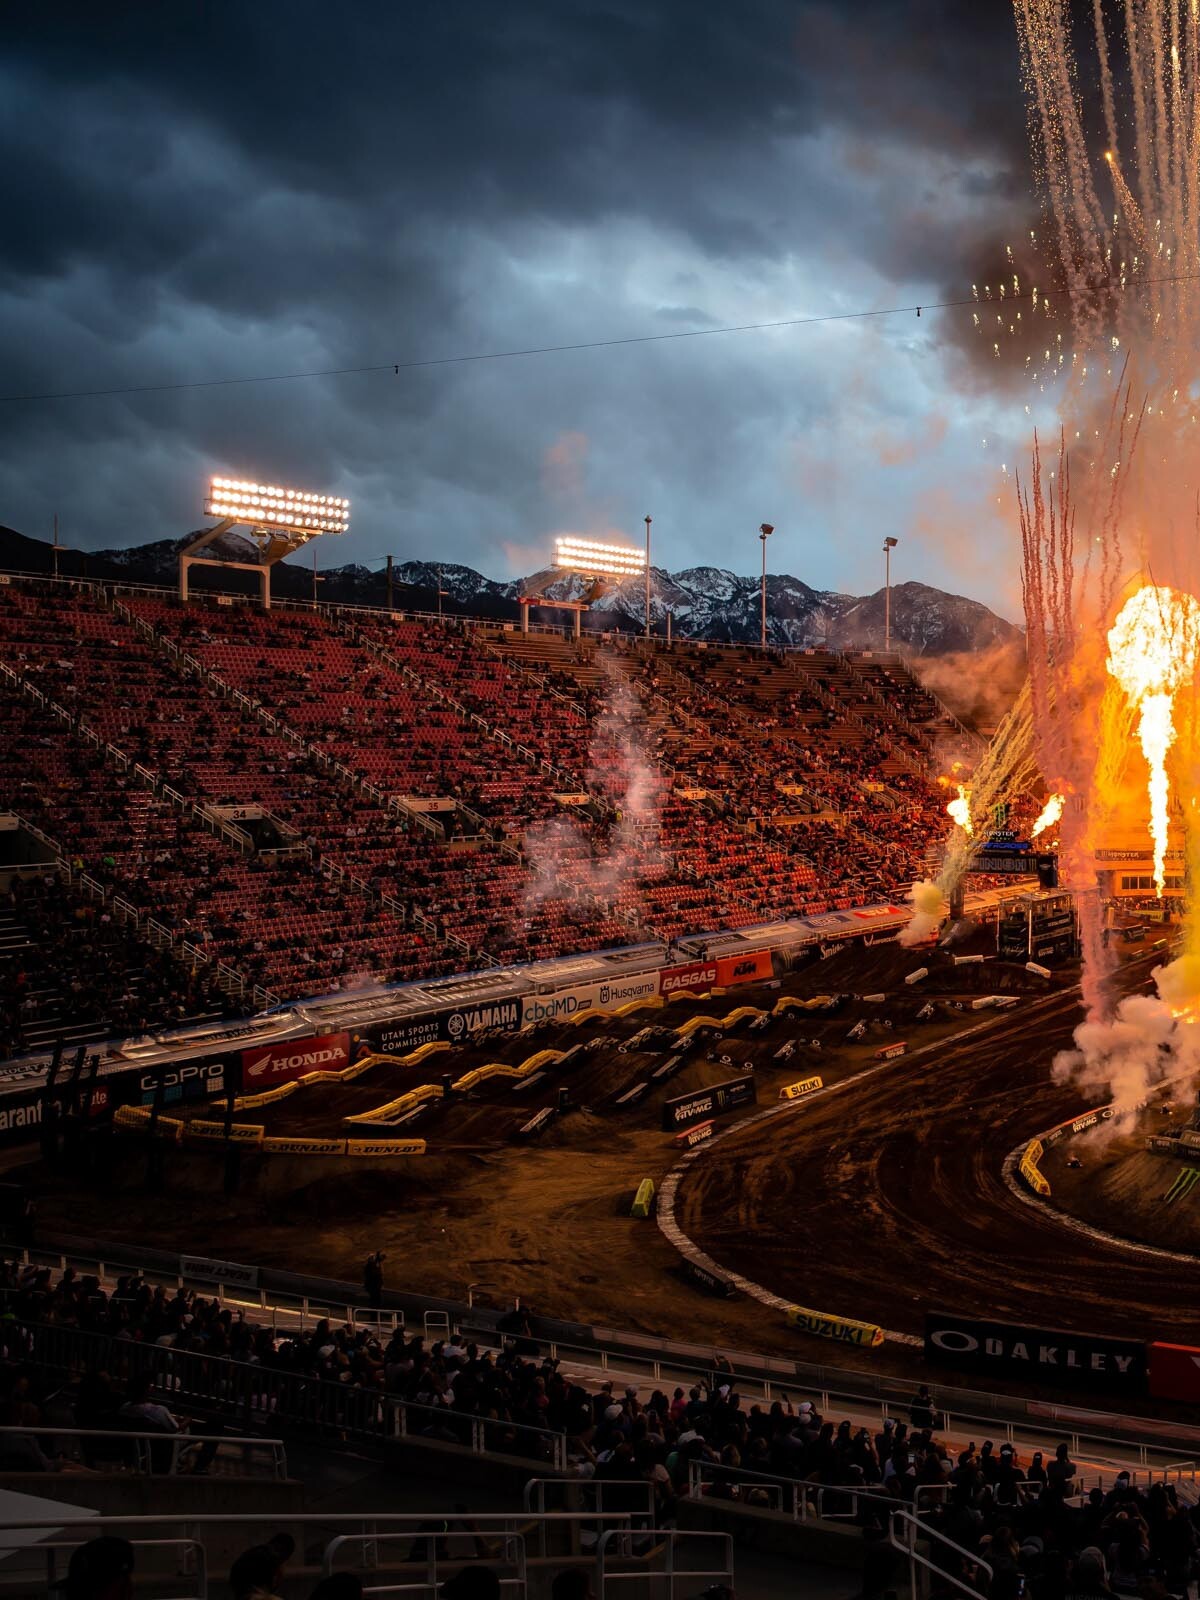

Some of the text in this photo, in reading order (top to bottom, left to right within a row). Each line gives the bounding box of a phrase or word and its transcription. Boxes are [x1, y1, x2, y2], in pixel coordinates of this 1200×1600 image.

[233, 810, 246, 819] 34
[428, 802, 438, 810] 35
[733, 960, 757, 976] KTM
[661, 968, 717, 991] GASGAS
[610, 982, 655, 1000] Husqvarna
[464, 1002, 519, 1032] YAMAHA
[525, 996, 578, 1021] cbdMD
[381, 1032, 439, 1052] COMMISSION
[382, 1022, 440, 1042] UTAH SPORTS
[272, 1047, 348, 1072] HONDA
[791, 1078, 820, 1096] SUZUKI
[277, 1143, 341, 1153] DUNLOP
[363, 1144, 422, 1154] DUNLOP
[797, 1313, 863, 1344] SUZUKI
[984, 1336, 1135, 1375] OAKLEY
